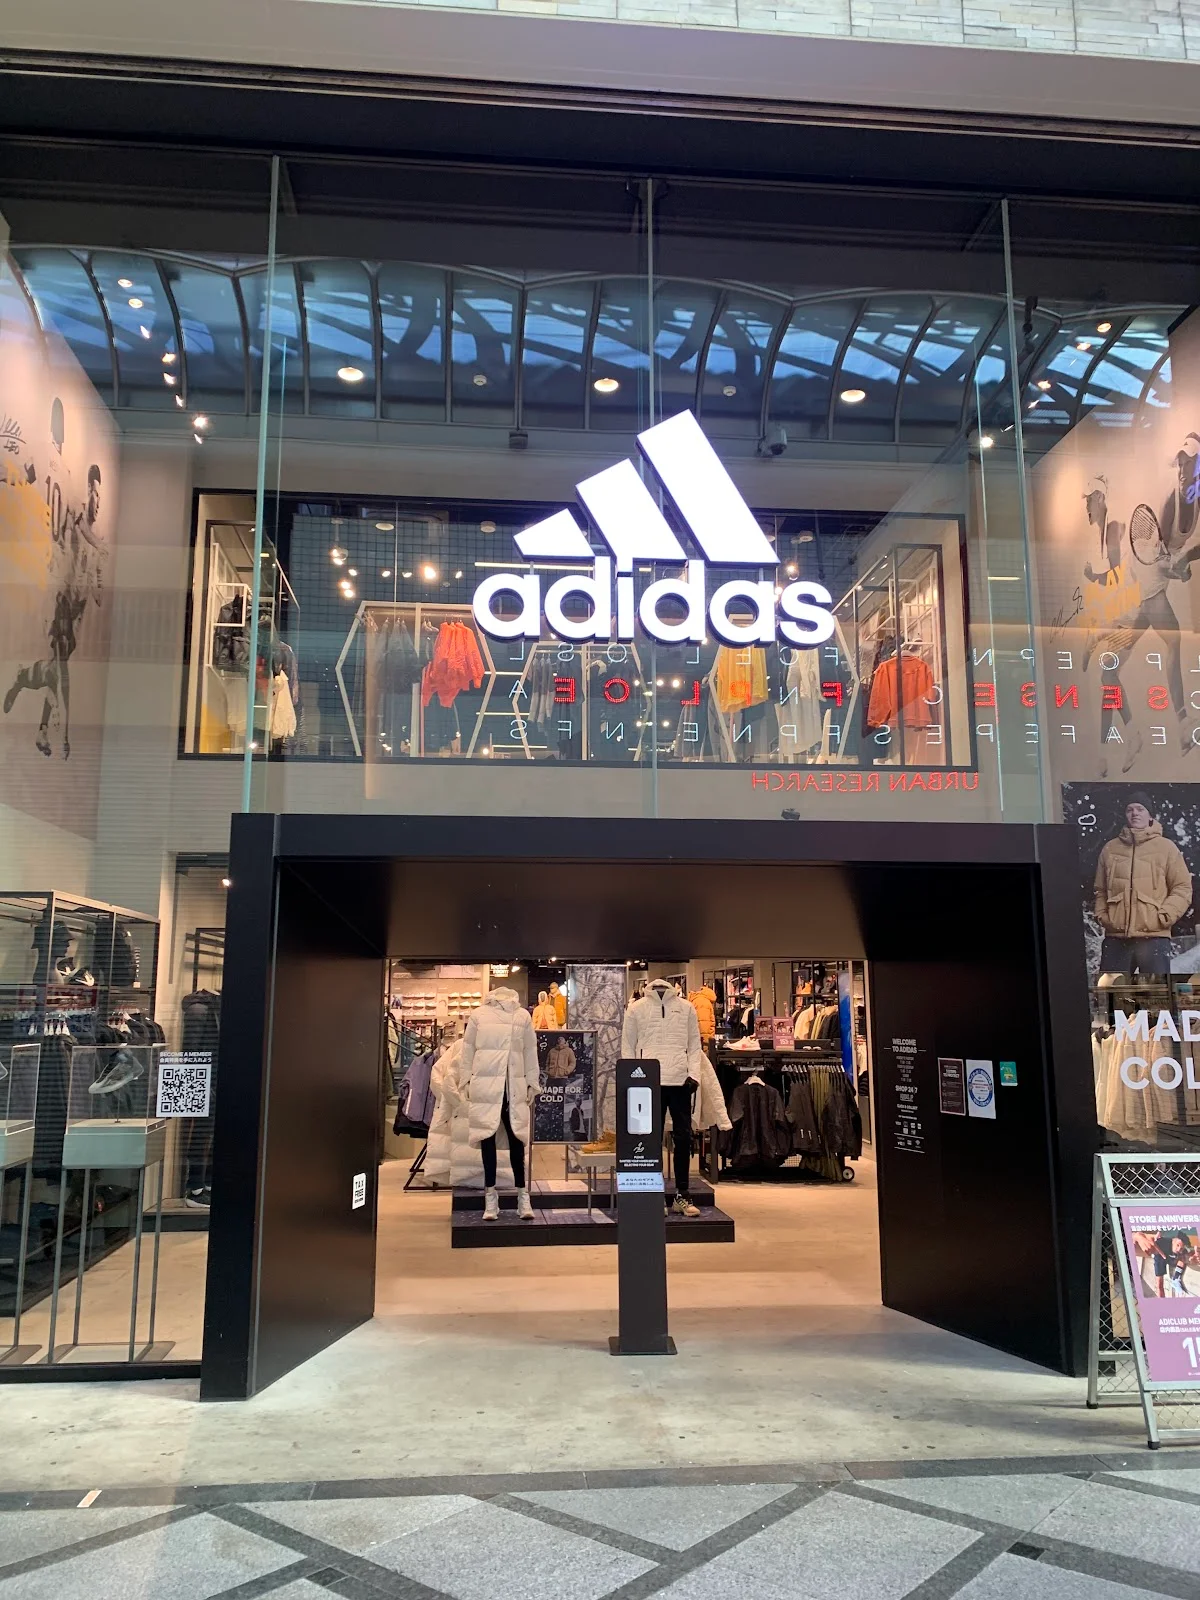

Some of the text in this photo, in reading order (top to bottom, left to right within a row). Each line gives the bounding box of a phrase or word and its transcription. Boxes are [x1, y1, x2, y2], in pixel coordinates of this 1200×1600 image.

[472, 556, 835, 649] adidas
[540, 1086, 563, 1094] MADE
[355, 1181, 364, 1189] TAX
[1129, 1214, 1200, 1223] STORE ANNIVERS
